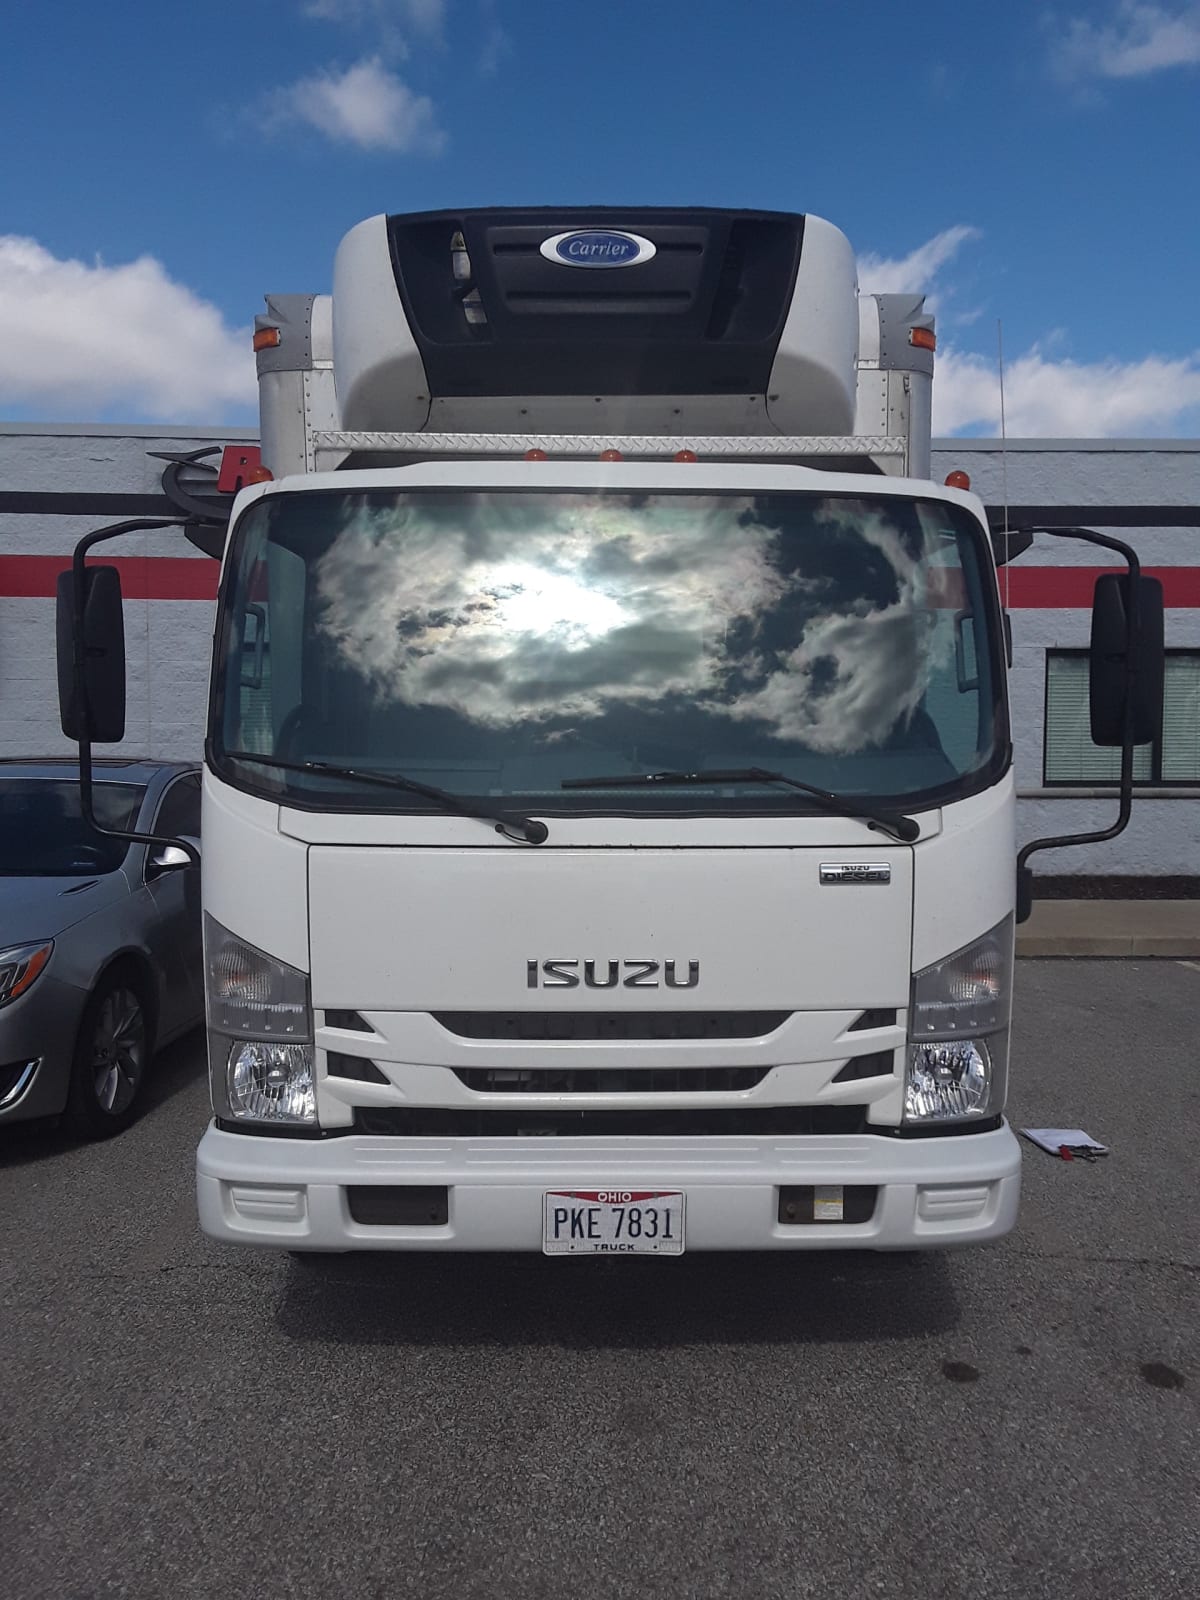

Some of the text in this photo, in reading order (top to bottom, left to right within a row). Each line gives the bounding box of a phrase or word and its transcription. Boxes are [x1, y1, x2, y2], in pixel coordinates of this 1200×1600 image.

[568, 240, 629, 256] Carrier
[527, 959, 699, 989] ISUZU
[597, 1192, 632, 1203] OHIO
[554, 1207, 674, 1239] PKE 7831
[593, 1243, 635, 1251] TRUCK
